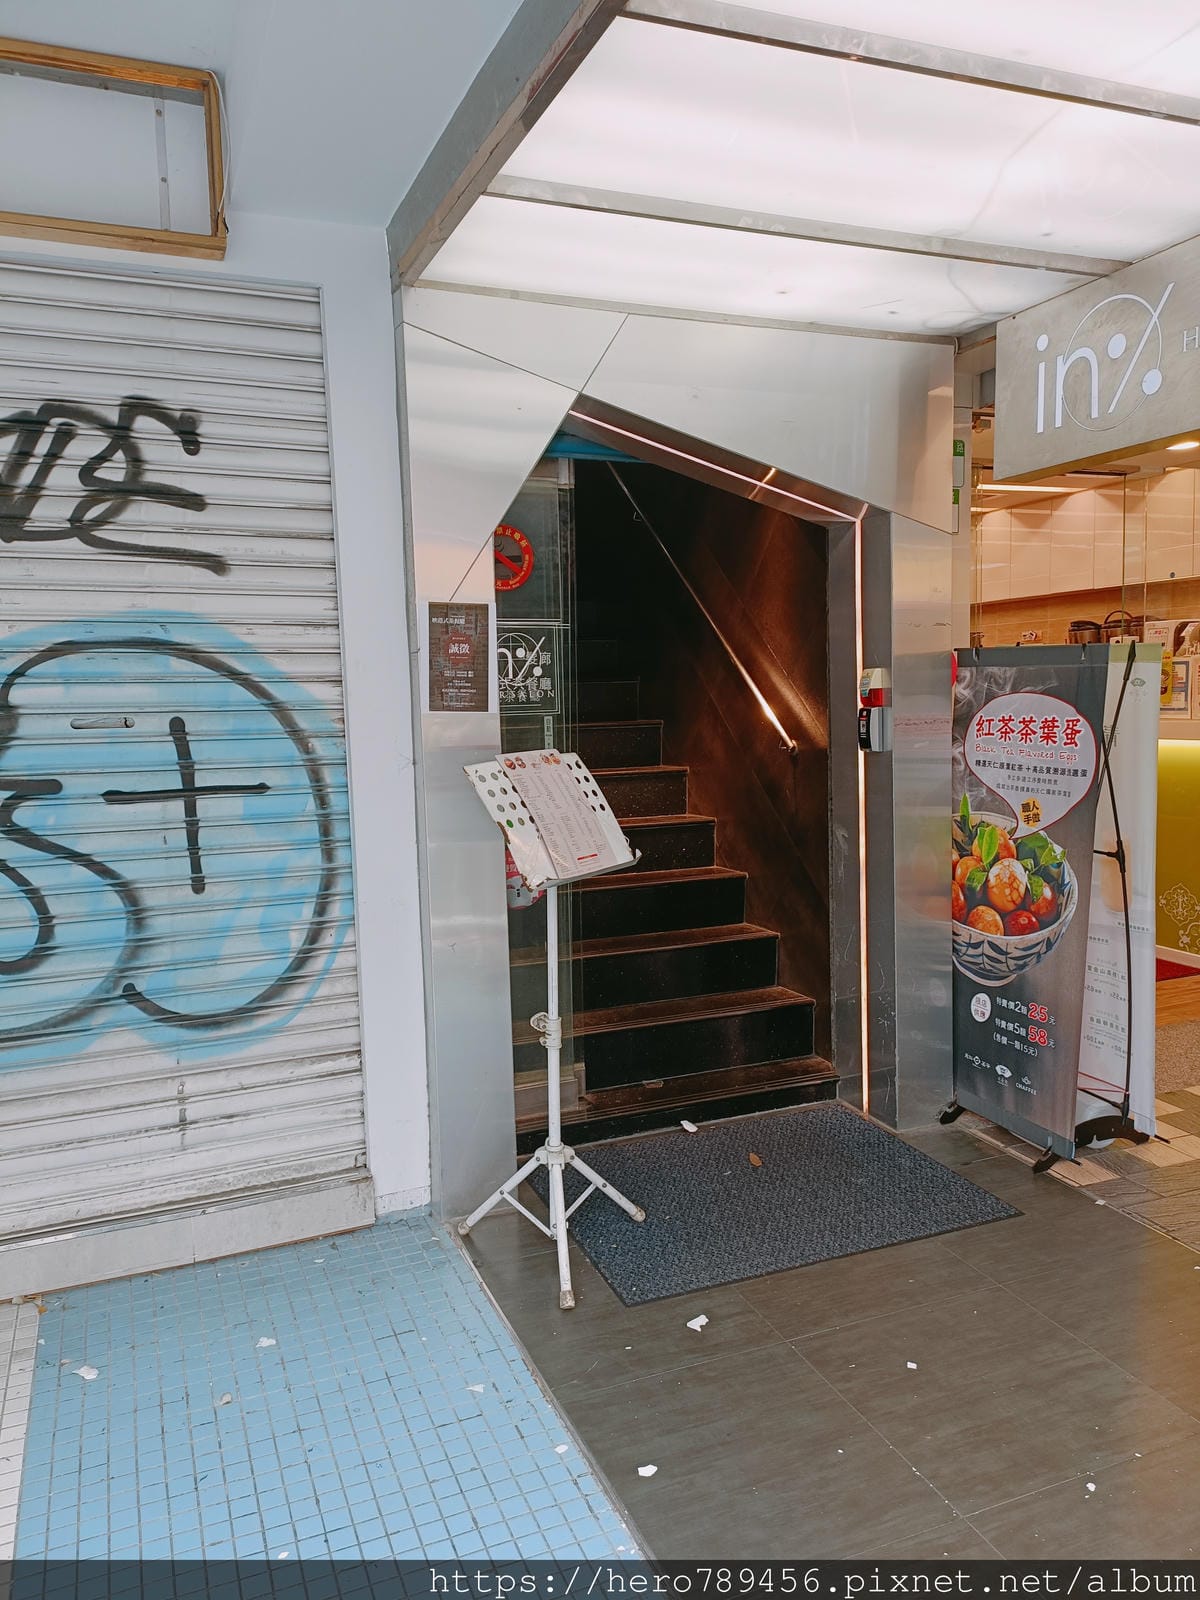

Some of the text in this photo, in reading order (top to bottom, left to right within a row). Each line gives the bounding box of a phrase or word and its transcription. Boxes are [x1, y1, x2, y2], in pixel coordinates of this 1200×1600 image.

[975, 715, 1082, 747] 紅茶茶葉蛋
[975, 743, 1078, 765] Black Tea Flavored Eggs
[1015, 1082, 1037, 1096] CHAFFEE
